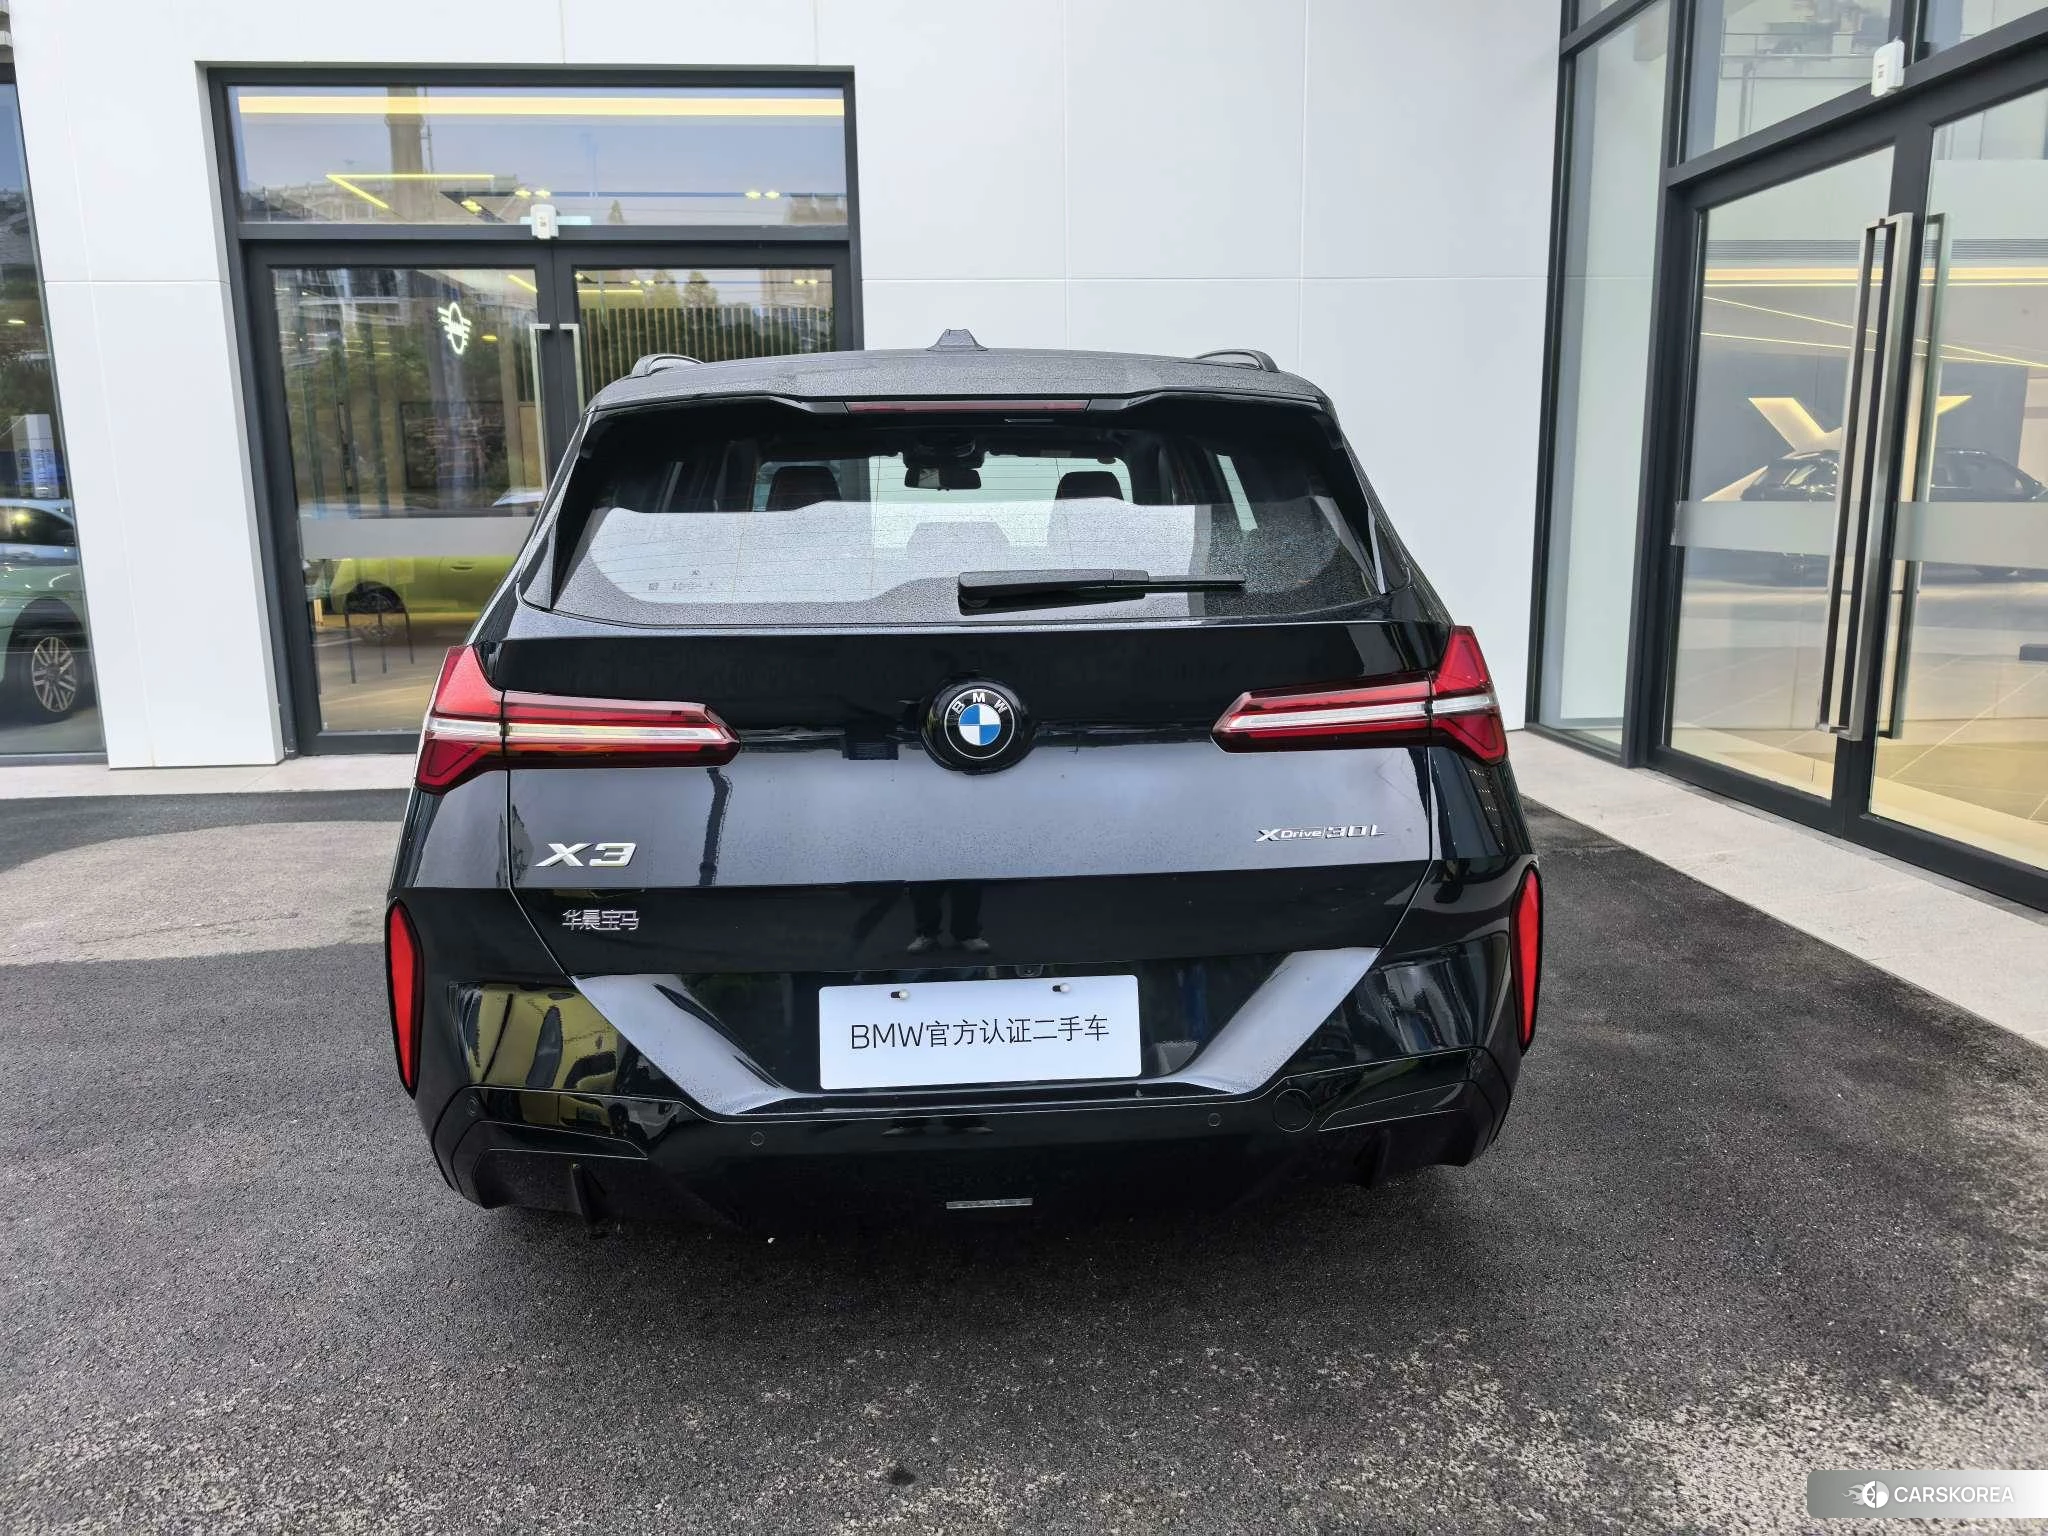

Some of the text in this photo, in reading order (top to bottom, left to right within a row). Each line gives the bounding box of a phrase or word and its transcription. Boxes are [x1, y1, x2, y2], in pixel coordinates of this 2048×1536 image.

[951, 692, 1008, 714] BMW
[534, 842, 637, 867] X3
[562, 909, 640, 931] 华晨宝马
[850, 1014, 1110, 1050] BMW官方认证二手车
